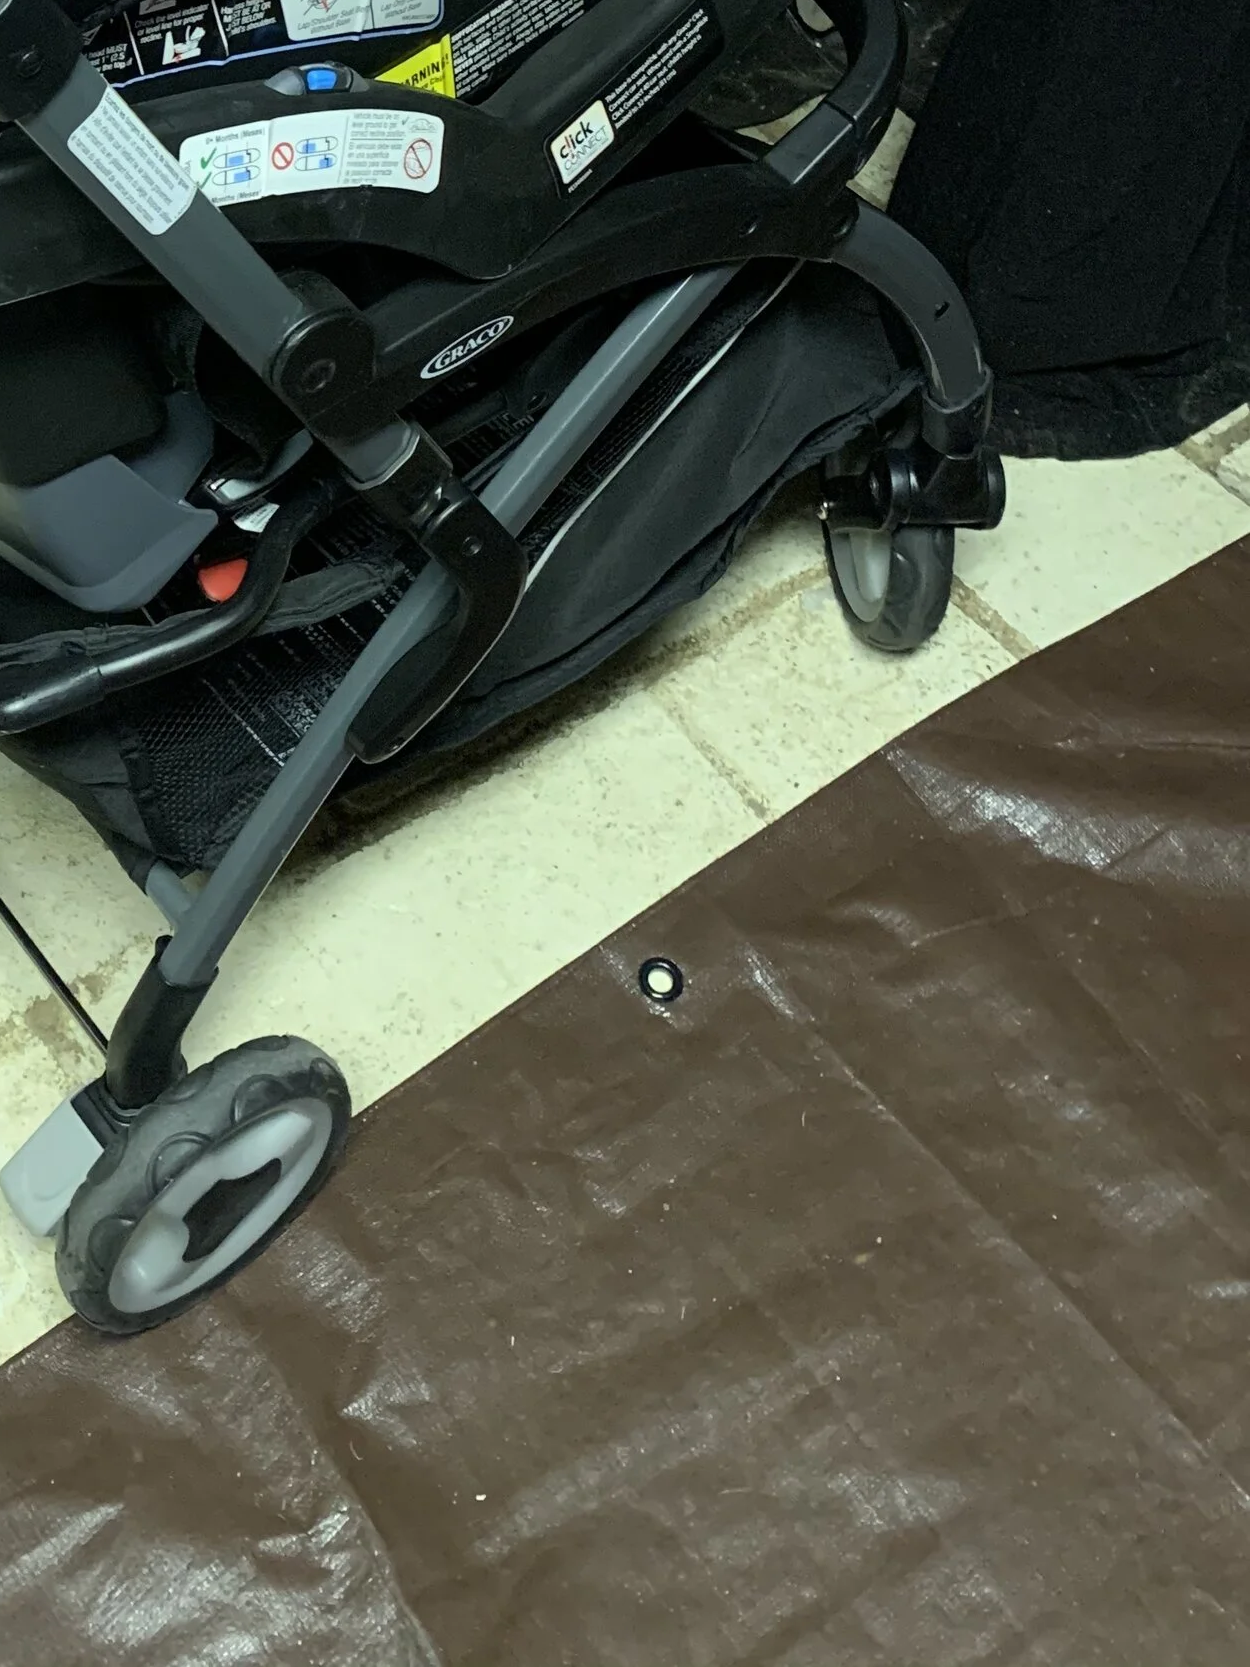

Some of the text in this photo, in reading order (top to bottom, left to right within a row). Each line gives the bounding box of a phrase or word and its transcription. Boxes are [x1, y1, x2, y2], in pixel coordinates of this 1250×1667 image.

[400, 53, 449, 86] ARNING!
[560, 121, 594, 160] click
[564, 125, 607, 171] CONNECT
[434, 322, 503, 368] GRACO
